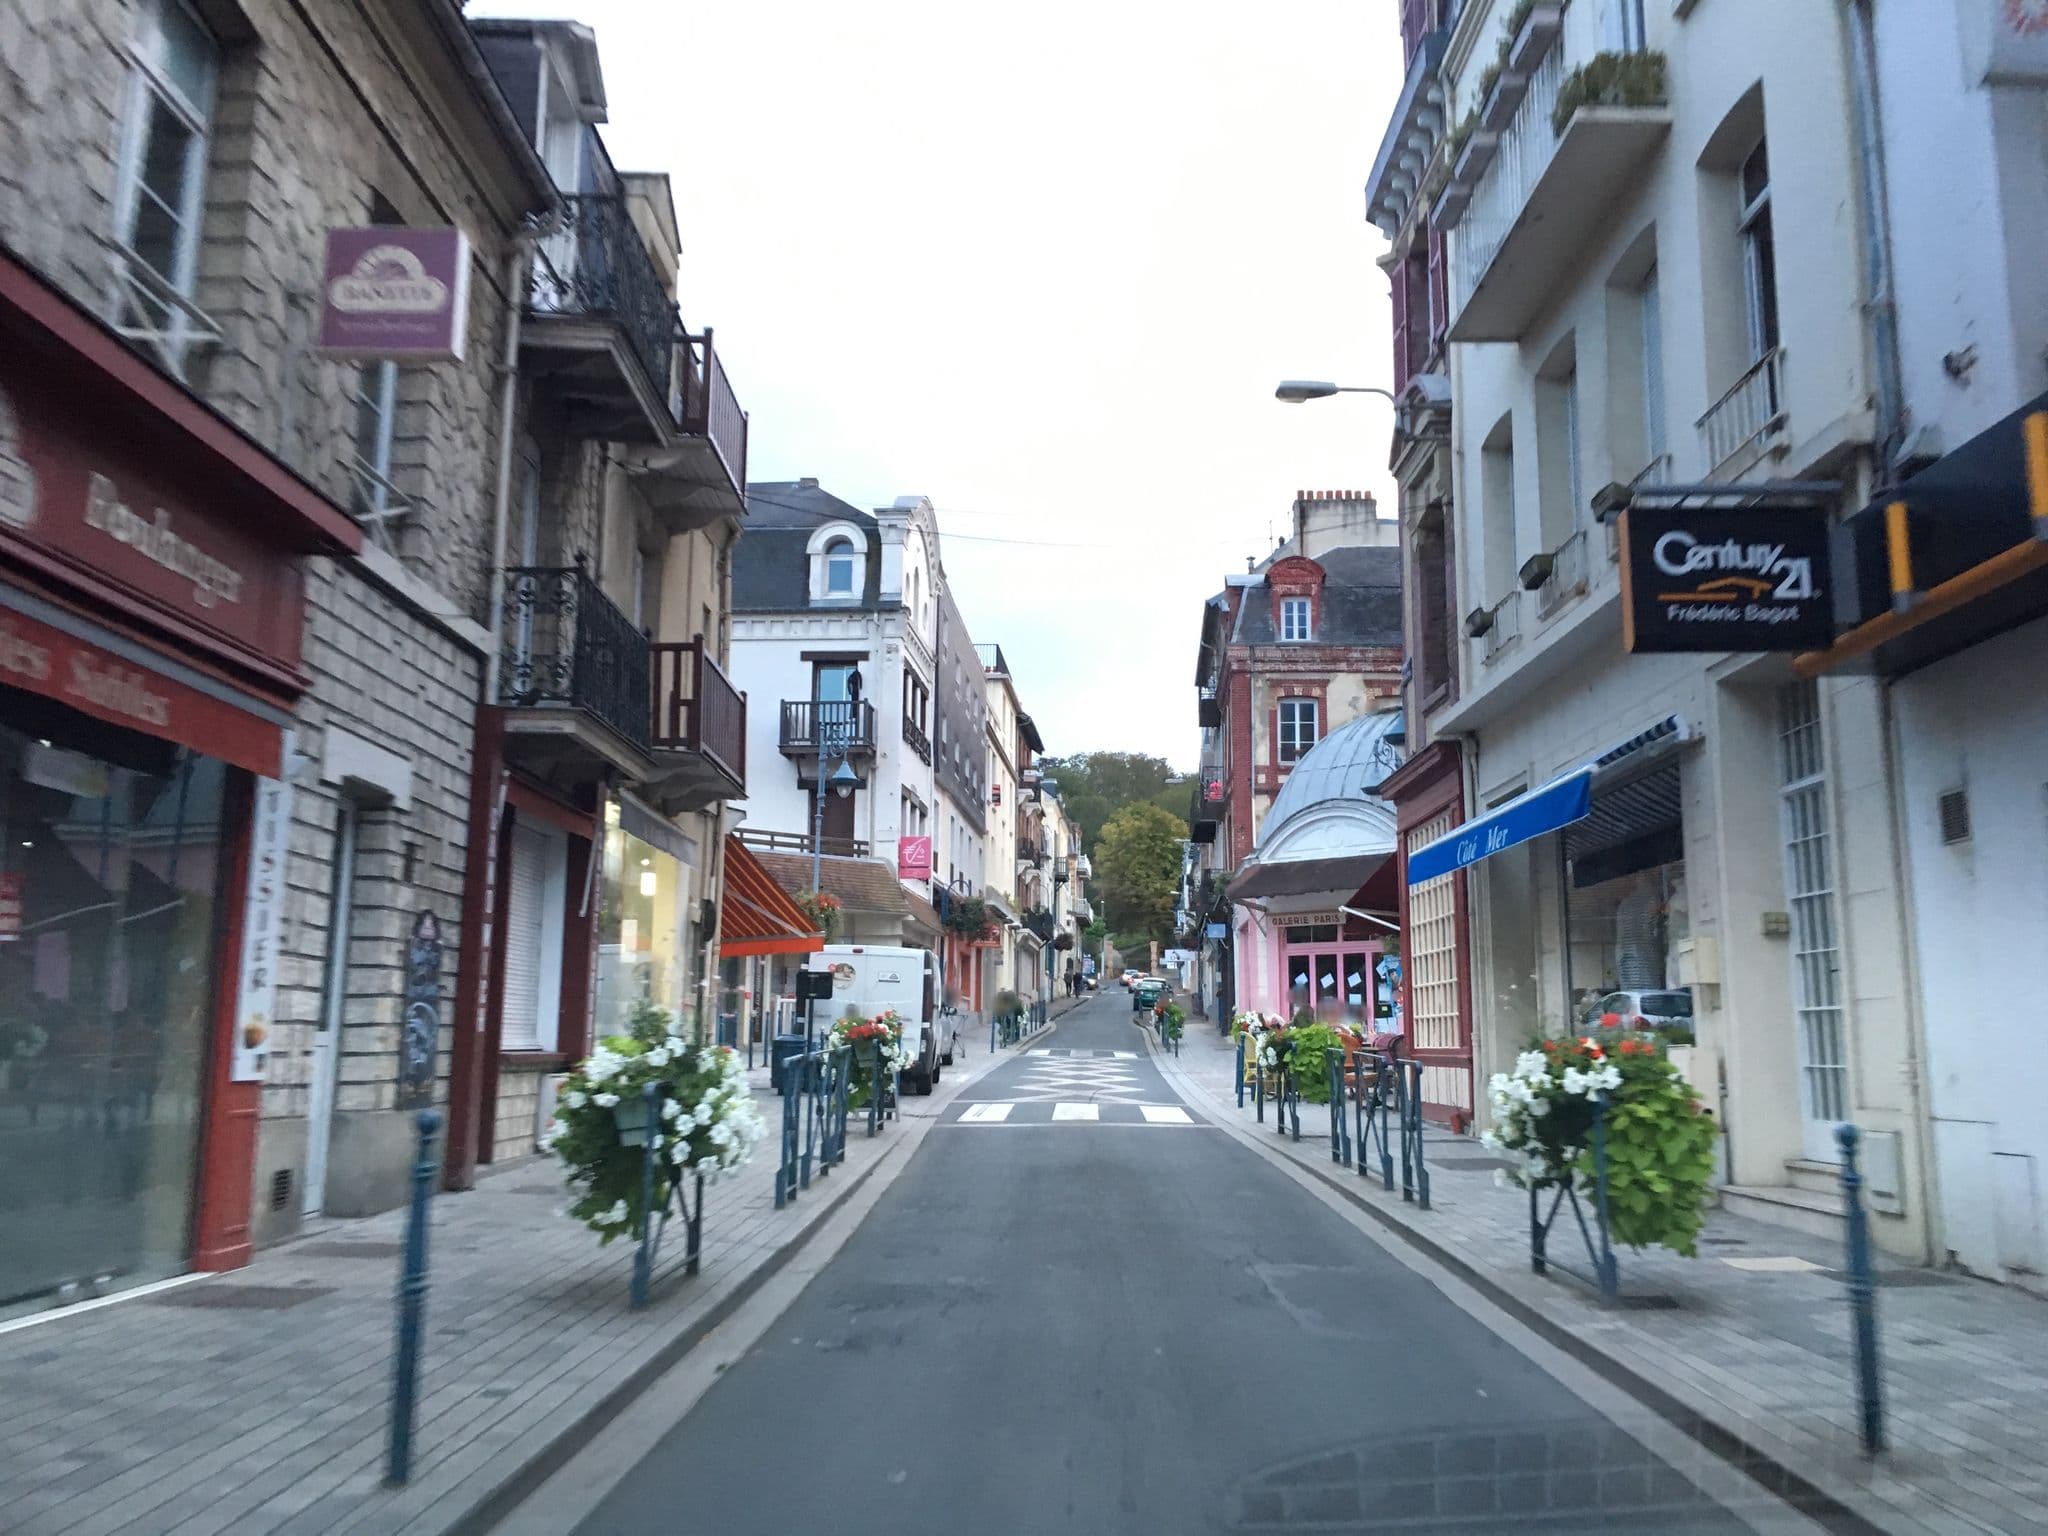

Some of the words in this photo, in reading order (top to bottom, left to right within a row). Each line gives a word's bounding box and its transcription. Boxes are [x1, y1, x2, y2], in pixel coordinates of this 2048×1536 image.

[1654, 531, 1785, 575] Century
[1771, 556, 1812, 600] 21
[1484, 825, 1509, 854] Mer
[1271, 915, 1310, 926] GALERIE
[1313, 914, 1341, 924] PARIS
